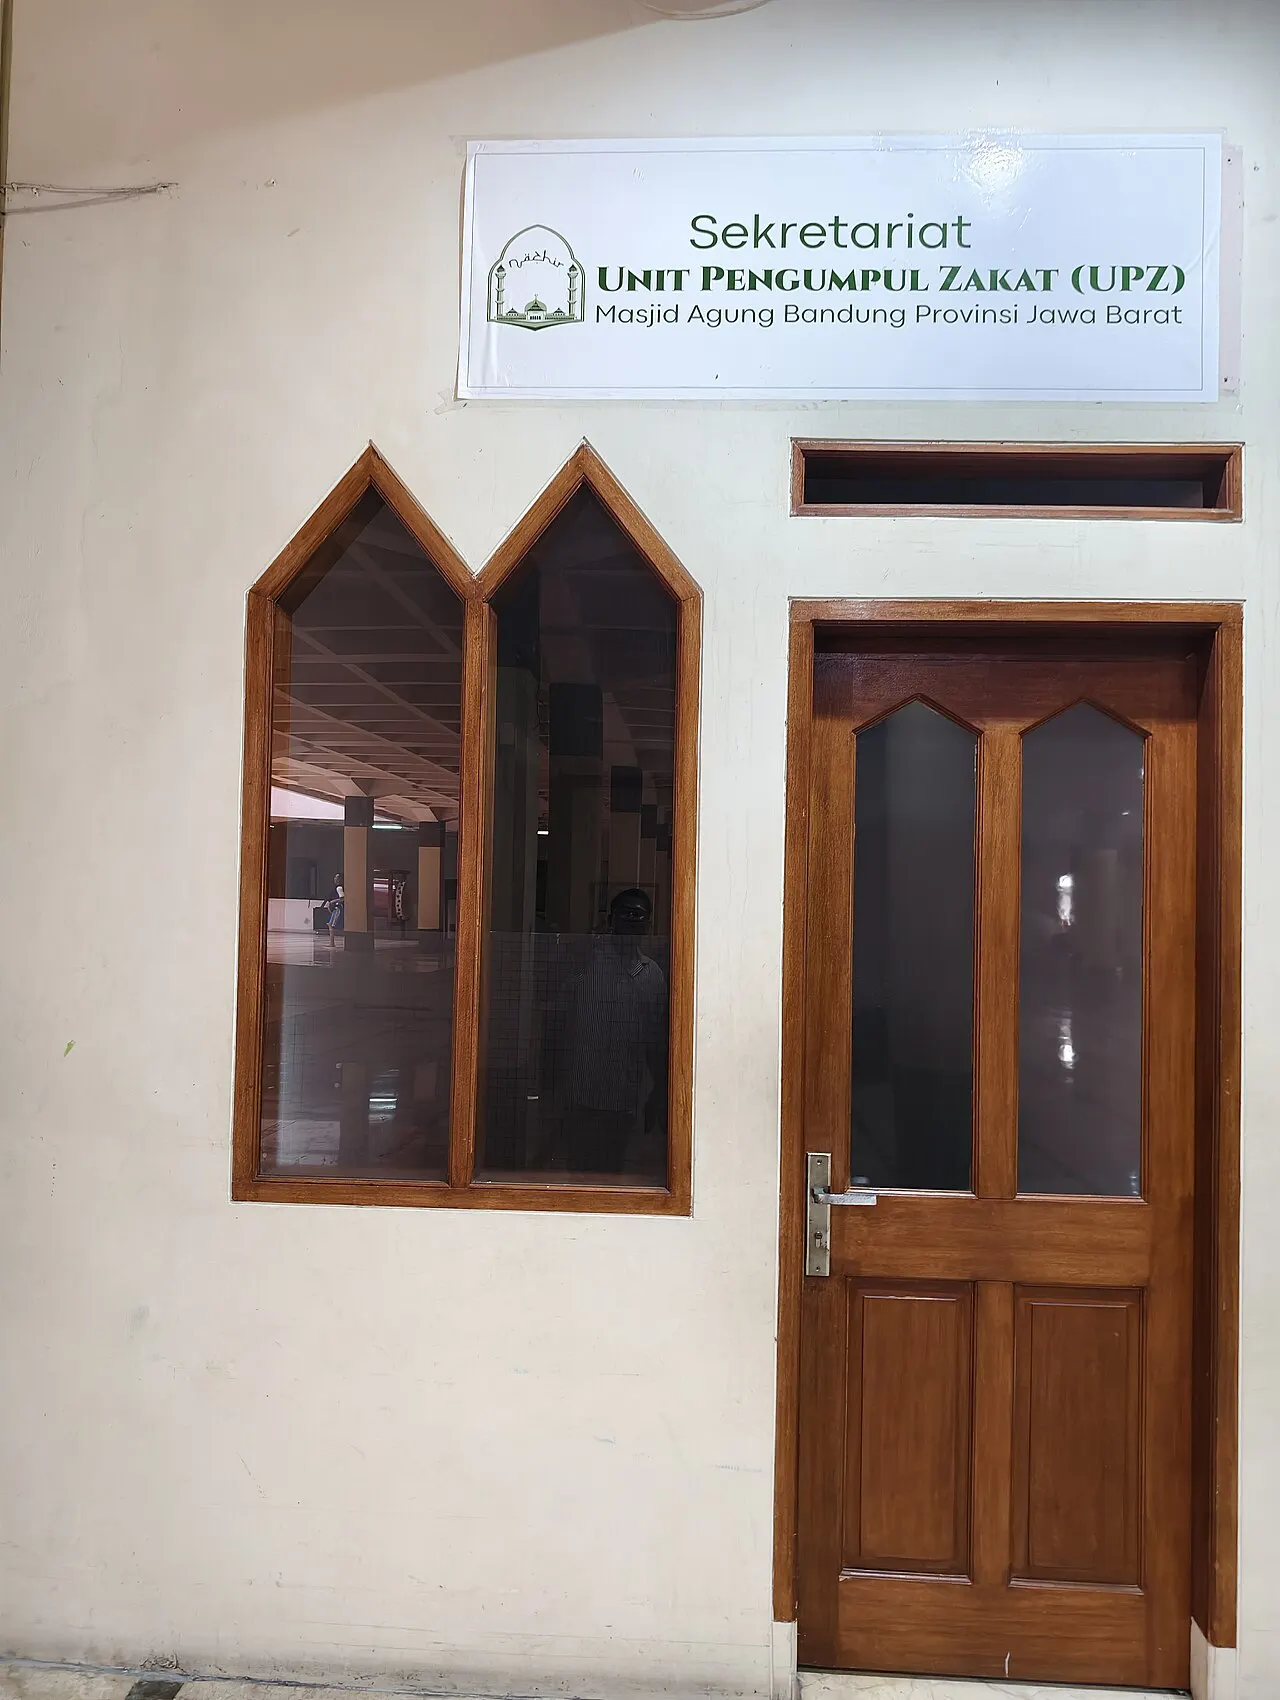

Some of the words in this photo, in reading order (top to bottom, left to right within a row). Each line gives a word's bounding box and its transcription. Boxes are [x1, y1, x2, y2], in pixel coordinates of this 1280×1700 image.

[689, 212, 972, 250] Sekretariat
[597, 265, 691, 293] UNIT
[699, 265, 930, 292] PENGUMPUL
[938, 264, 1060, 292] ZAKAT
[1072, 264, 1186, 296] (UPZ)
[595, 303, 679, 328] Masjid
[687, 304, 774, 329] Agung
[784, 303, 906, 329] Bandung
[915, 303, 1018, 325] Provinsi
[1026, 304, 1096, 325] Jawa
[1106, 303, 1183, 325] Barat
